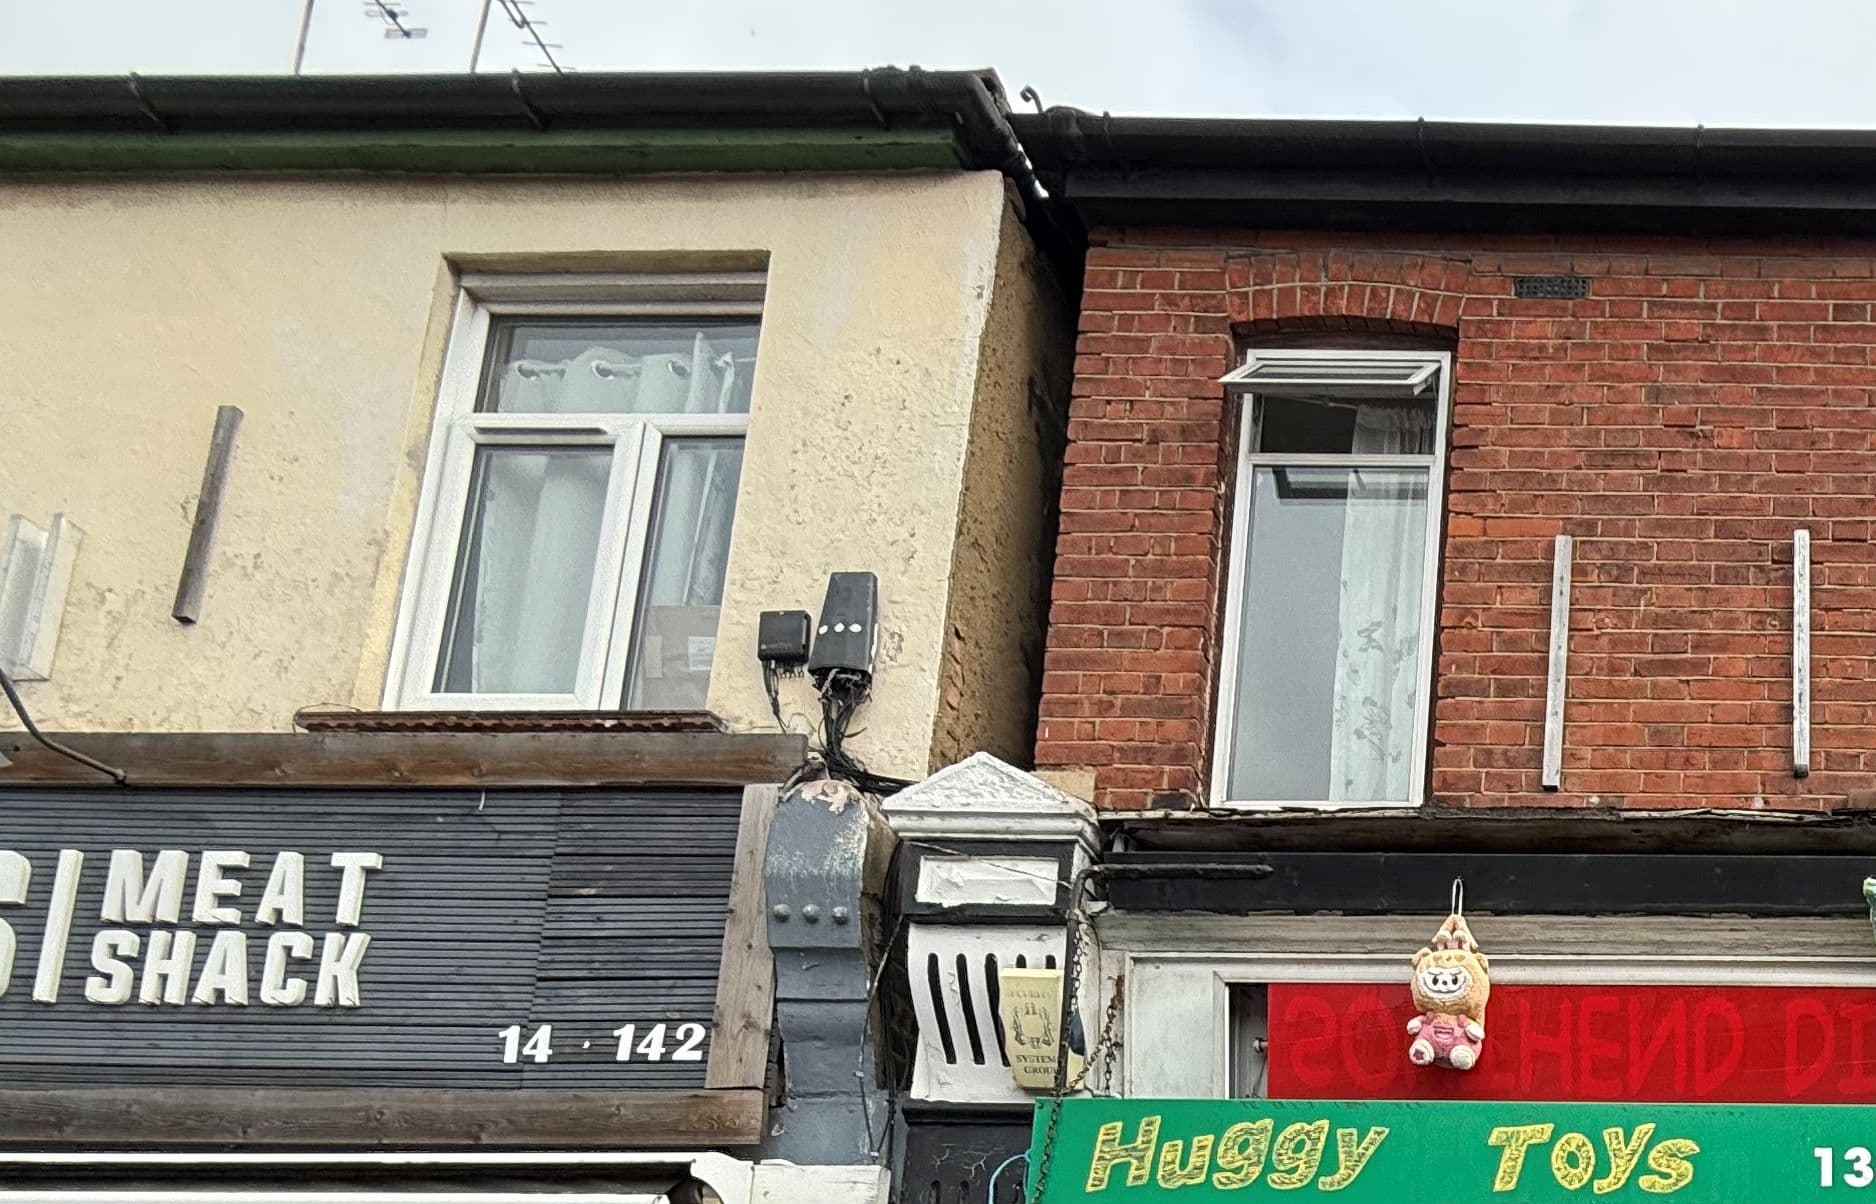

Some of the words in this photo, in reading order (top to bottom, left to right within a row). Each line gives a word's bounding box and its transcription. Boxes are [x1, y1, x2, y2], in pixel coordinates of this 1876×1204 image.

[100, 848, 384, 927] MEAT
[84, 929, 372, 1008] SHACK
[612, 1022, 706, 1063] 142
[1085, 1114, 1391, 1194] Huggy
